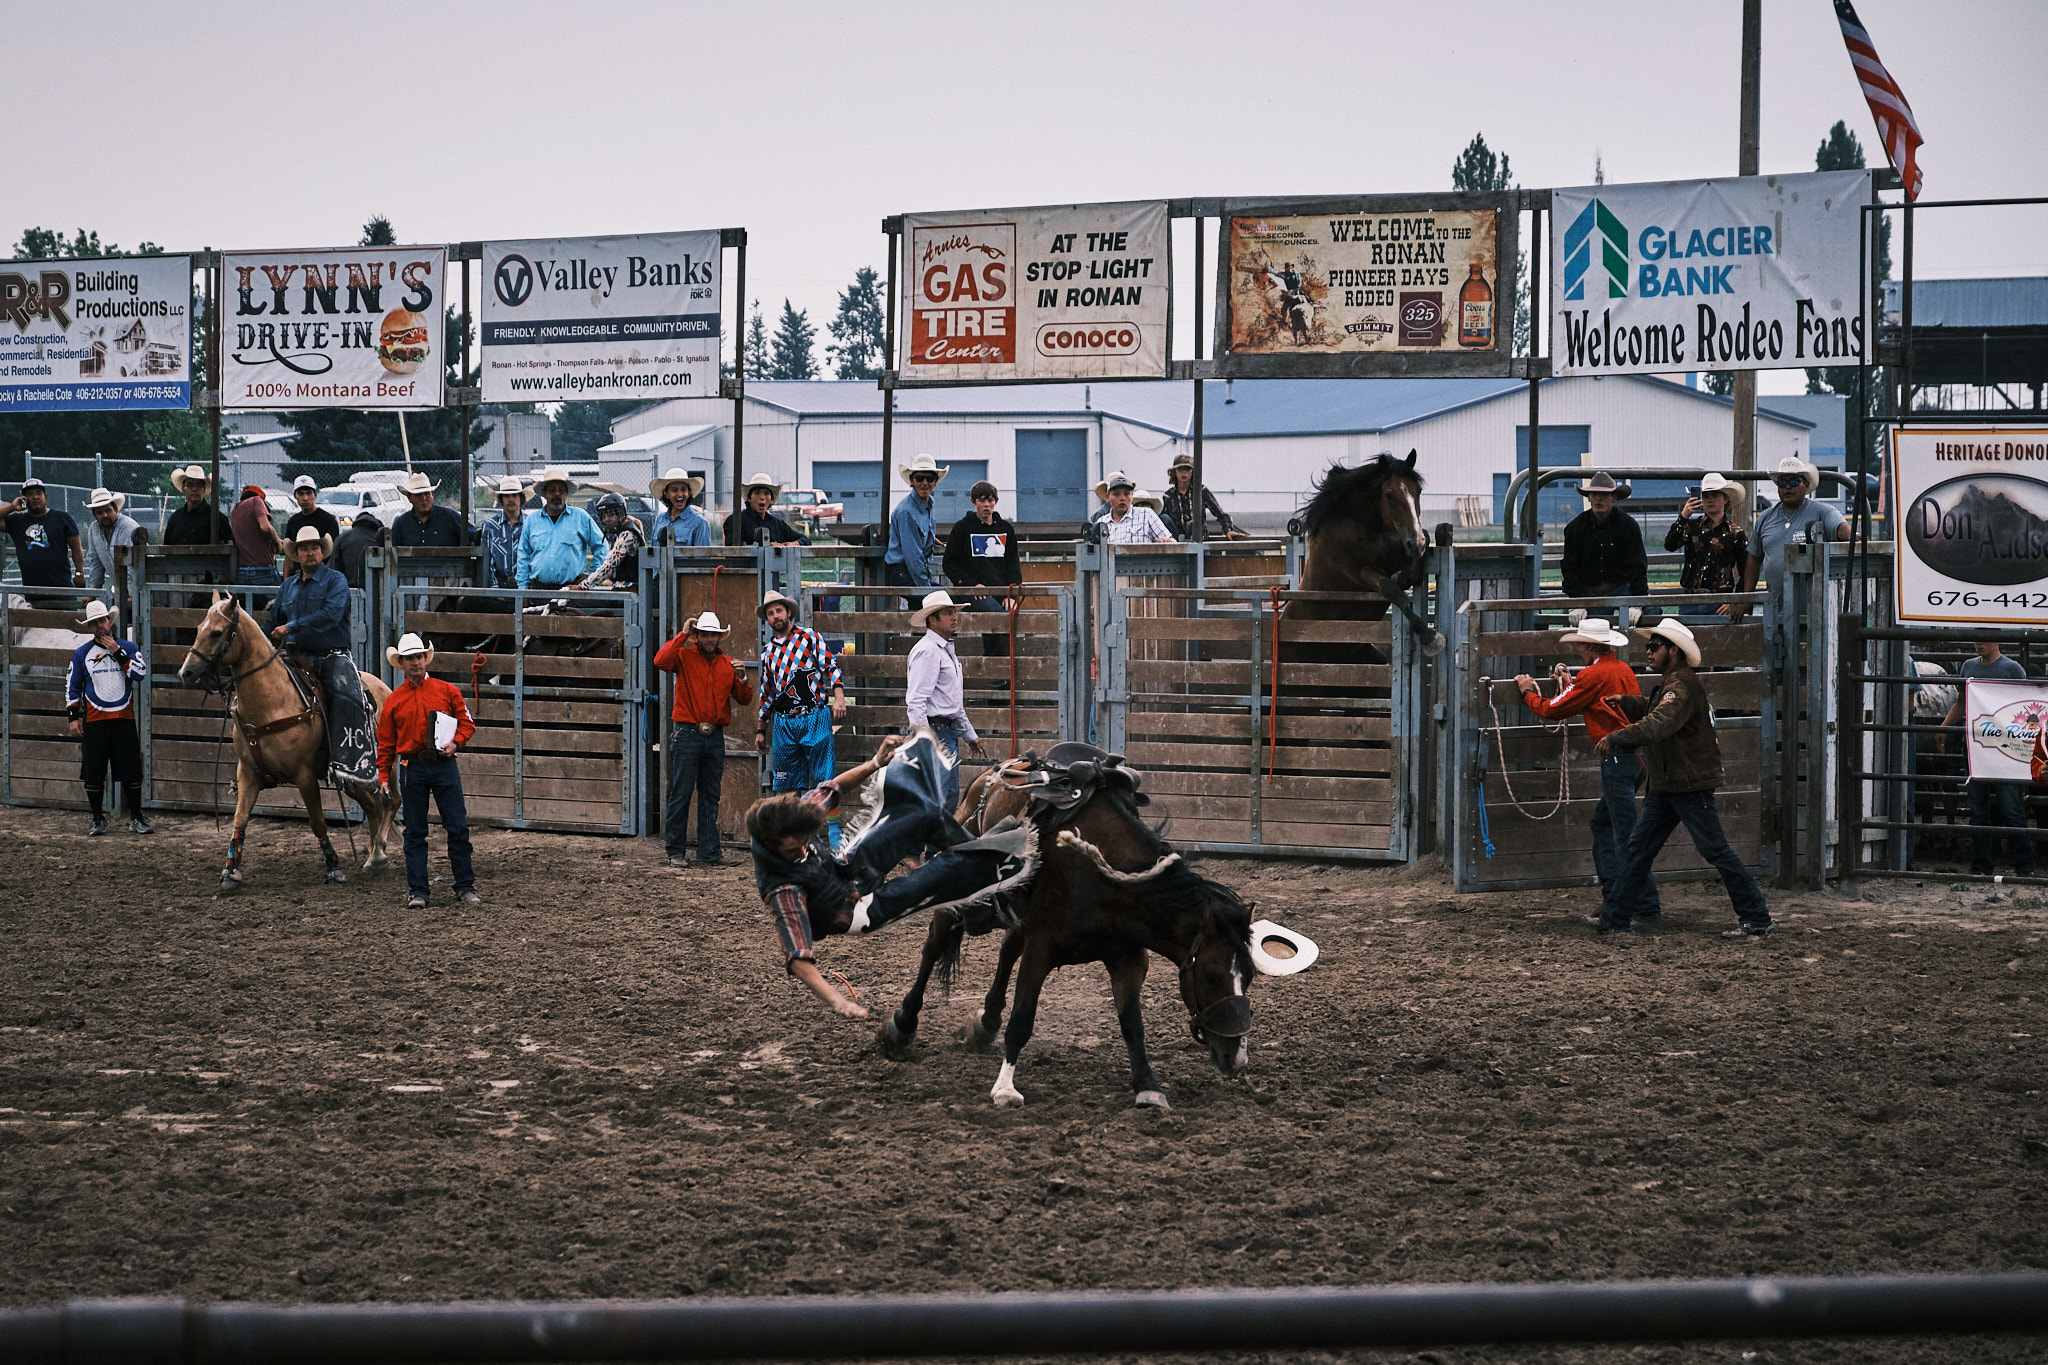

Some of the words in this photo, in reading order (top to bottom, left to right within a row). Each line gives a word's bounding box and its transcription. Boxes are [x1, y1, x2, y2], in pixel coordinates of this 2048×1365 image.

[1330, 218, 1435, 242] WELCOME
[1437, 229, 1449, 240] TO
[1452, 227, 1472, 239] THE
[922, 234, 971, 271] Arnies
[1050, 234, 1077, 254] AT
[1086, 232, 1128, 252] THE
[1639, 225, 1774, 261] GLACIER
[1371, 242, 1445, 265] RONAN
[534, 259, 619, 298] Valley
[627, 254, 713, 288] Banks
[1026, 260, 1082, 282] STOP
[1090, 258, 1154, 280] LIGHT
[1329, 269, 1397, 287] PIONEER
[1401, 267, 1450, 286] DAYS
[76, 271, 138, 295] Building
[235, 261, 433, 315] LYNN'S
[923, 262, 1007, 304] GAS
[1639, 264, 1735, 298] BANK
[0, 270, 72, 333] R&R
[1037, 289, 1058, 308] IN
[1066, 286, 1142, 307] RONAN
[1345, 289, 1395, 307] RODEO
[76, 298, 168, 318] Productions
[170, 305, 184, 316] LLC
[1405, 308, 1435, 321] 325
[494, 328, 537, 339] FRIENDLY.
[540, 325, 620, 337] KNOWLEDGEABLE.
[623, 322, 675, 334] COMMUNITY
[676, 321, 711, 332] DRIVEN.
[921, 309, 1007, 338] TIRE
[1348, 324, 1392, 333] SUMMIT
[1564, 308, 1685, 368] Welcome
[1696, 301, 1783, 363] Rodeo
[1795, 298, 1861, 359] Fans
[0, 337, 11, 345] ew
[14, 333, 68, 345] Construction,
[0, 349, 44, 361] ommercial,
[47, 348, 92, 359] Residential
[924, 340, 1001, 360] Center
[0, 366, 8, 376] nd
[11, 365, 52, 376] Remodels
[492, 361, 512, 369] Ronan
[529, 361, 552, 369] Springs
[557, 359, 589, 368] Thompson
[628, 357, 649, 365] Polson
[654, 356, 672, 364] Pablo
[686, 355, 710, 363] Ignatius
[245, 383, 291, 398] 100%
[297, 383, 371, 397] Montana
[377, 381, 415, 397] Beef
[510, 372, 692, 392] www.valleybankronan.com
[0, 389, 15, 404] ocky
[24, 388, 54, 401] Rachelle
[55, 388, 72, 400] Cote
[76, 387, 122, 399] 406-212-0357
[124, 389, 131, 398] or
[133, 386, 181, 399] 406-676-5554
[1936, 443, 2000, 461] HERITAGE
[1922, 497, 1972, 540] Don
[1928, 591, 2048, 608] 676-442
[1979, 721, 2003, 738] The
